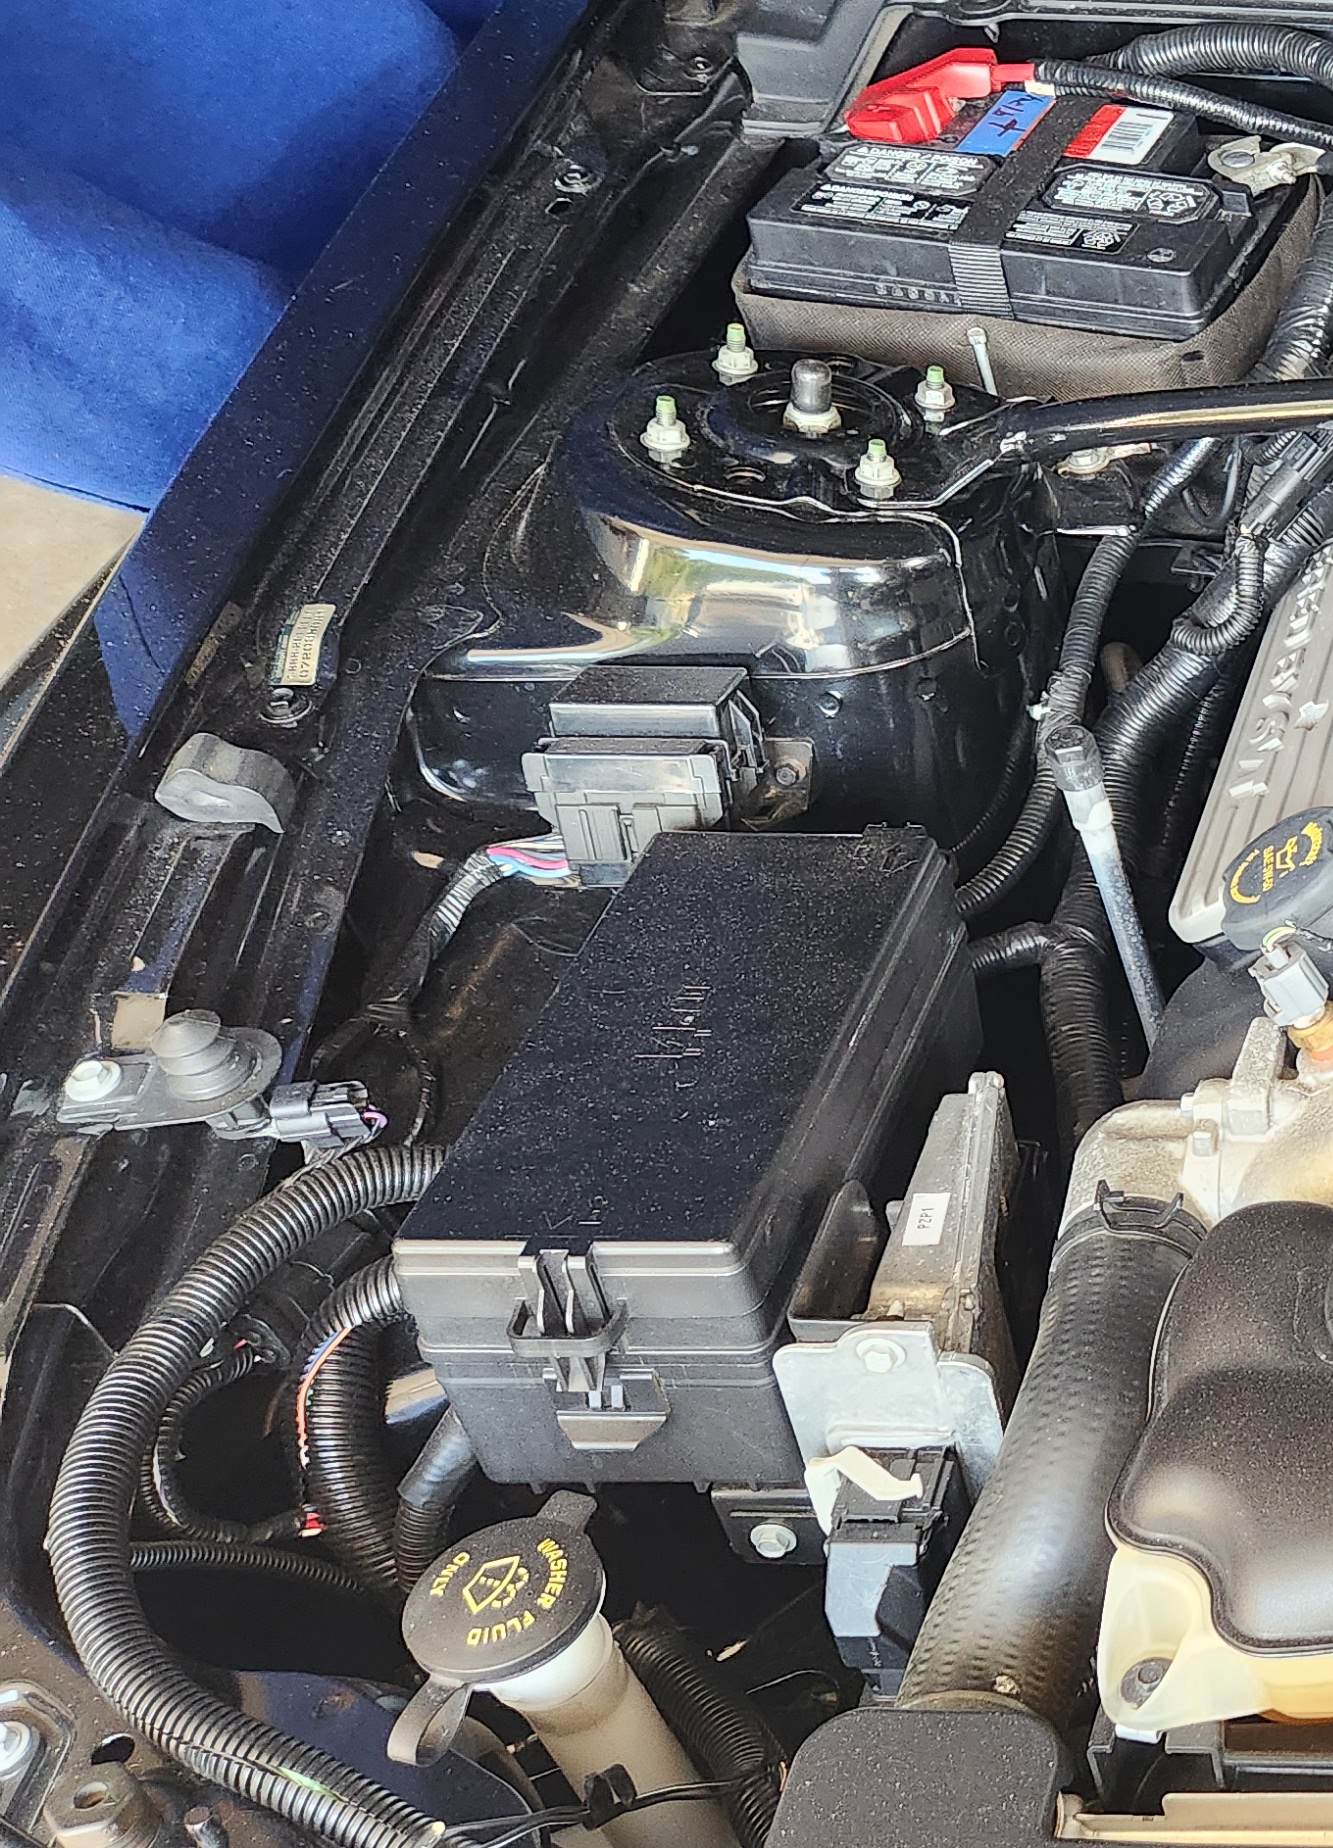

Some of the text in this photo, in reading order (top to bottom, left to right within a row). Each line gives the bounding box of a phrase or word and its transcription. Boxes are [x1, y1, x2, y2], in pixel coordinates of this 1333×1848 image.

[868, 148, 920, 159] DANGER
[932, 154, 978, 165] POISON
[430, 1537, 569, 1648] WASHER FLUID ONLY
